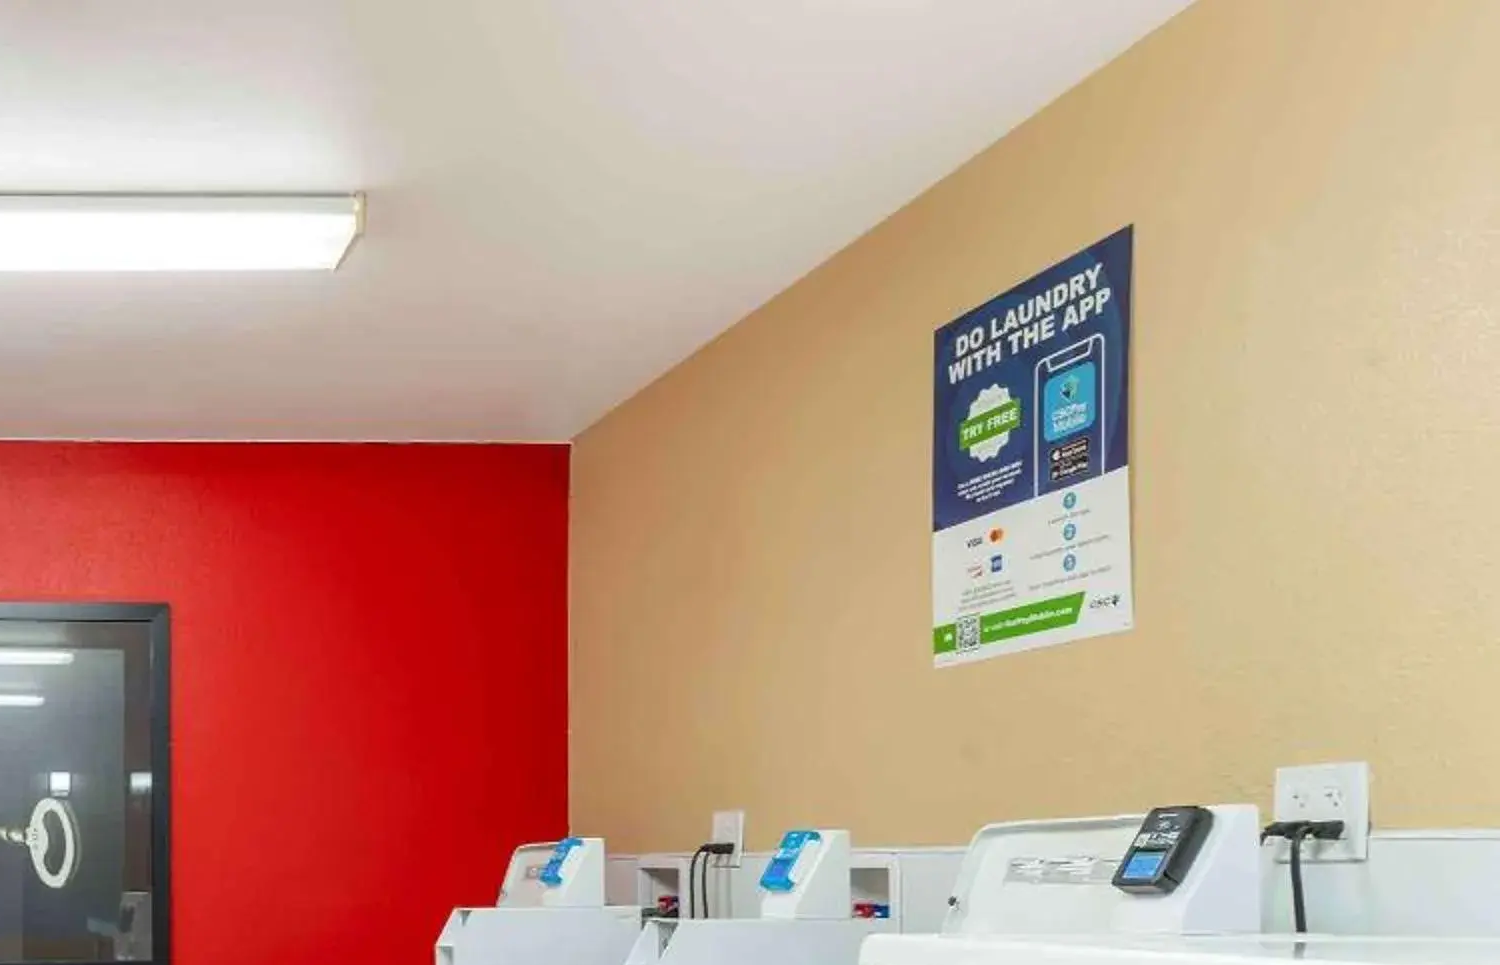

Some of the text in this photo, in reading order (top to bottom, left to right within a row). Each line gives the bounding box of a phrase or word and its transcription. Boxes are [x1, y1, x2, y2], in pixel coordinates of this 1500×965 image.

[948, 287, 1111, 385] WITH THE APP
[955, 262, 1103, 358] DO LAUNDRY
[962, 408, 1019, 441] TRY FREE
